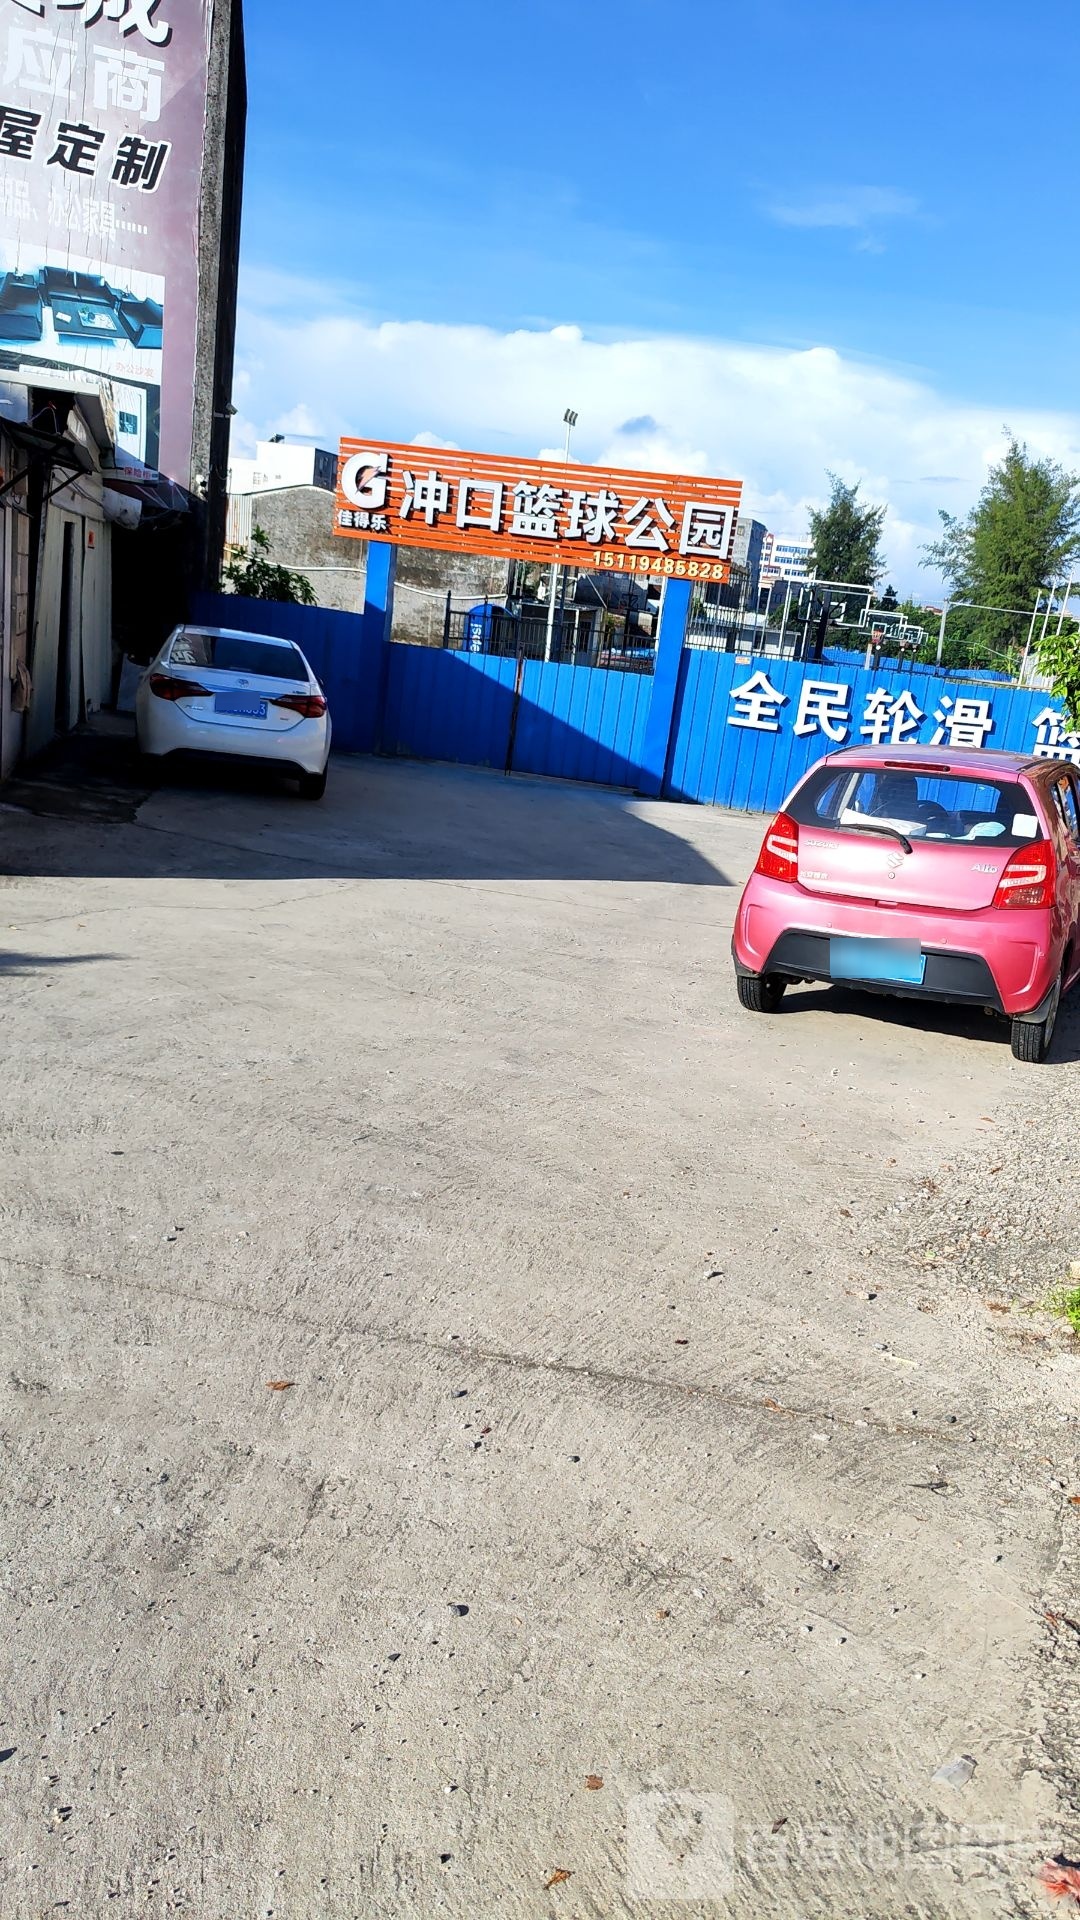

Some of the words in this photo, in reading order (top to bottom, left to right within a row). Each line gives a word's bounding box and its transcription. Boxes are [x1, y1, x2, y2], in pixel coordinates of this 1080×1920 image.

[2, 27, 165, 122] 应商
[0, 105, 169, 190] 屋定制
[342, 452, 387, 509] G
[337, 509, 387, 530] 佳得乐
[400, 470, 735, 560] 冲口篮球公园
[593, 550, 723, 580] 15119485828
[470, 623, 482, 654] epsi
[727, 671, 993, 748] 全民轮滑
